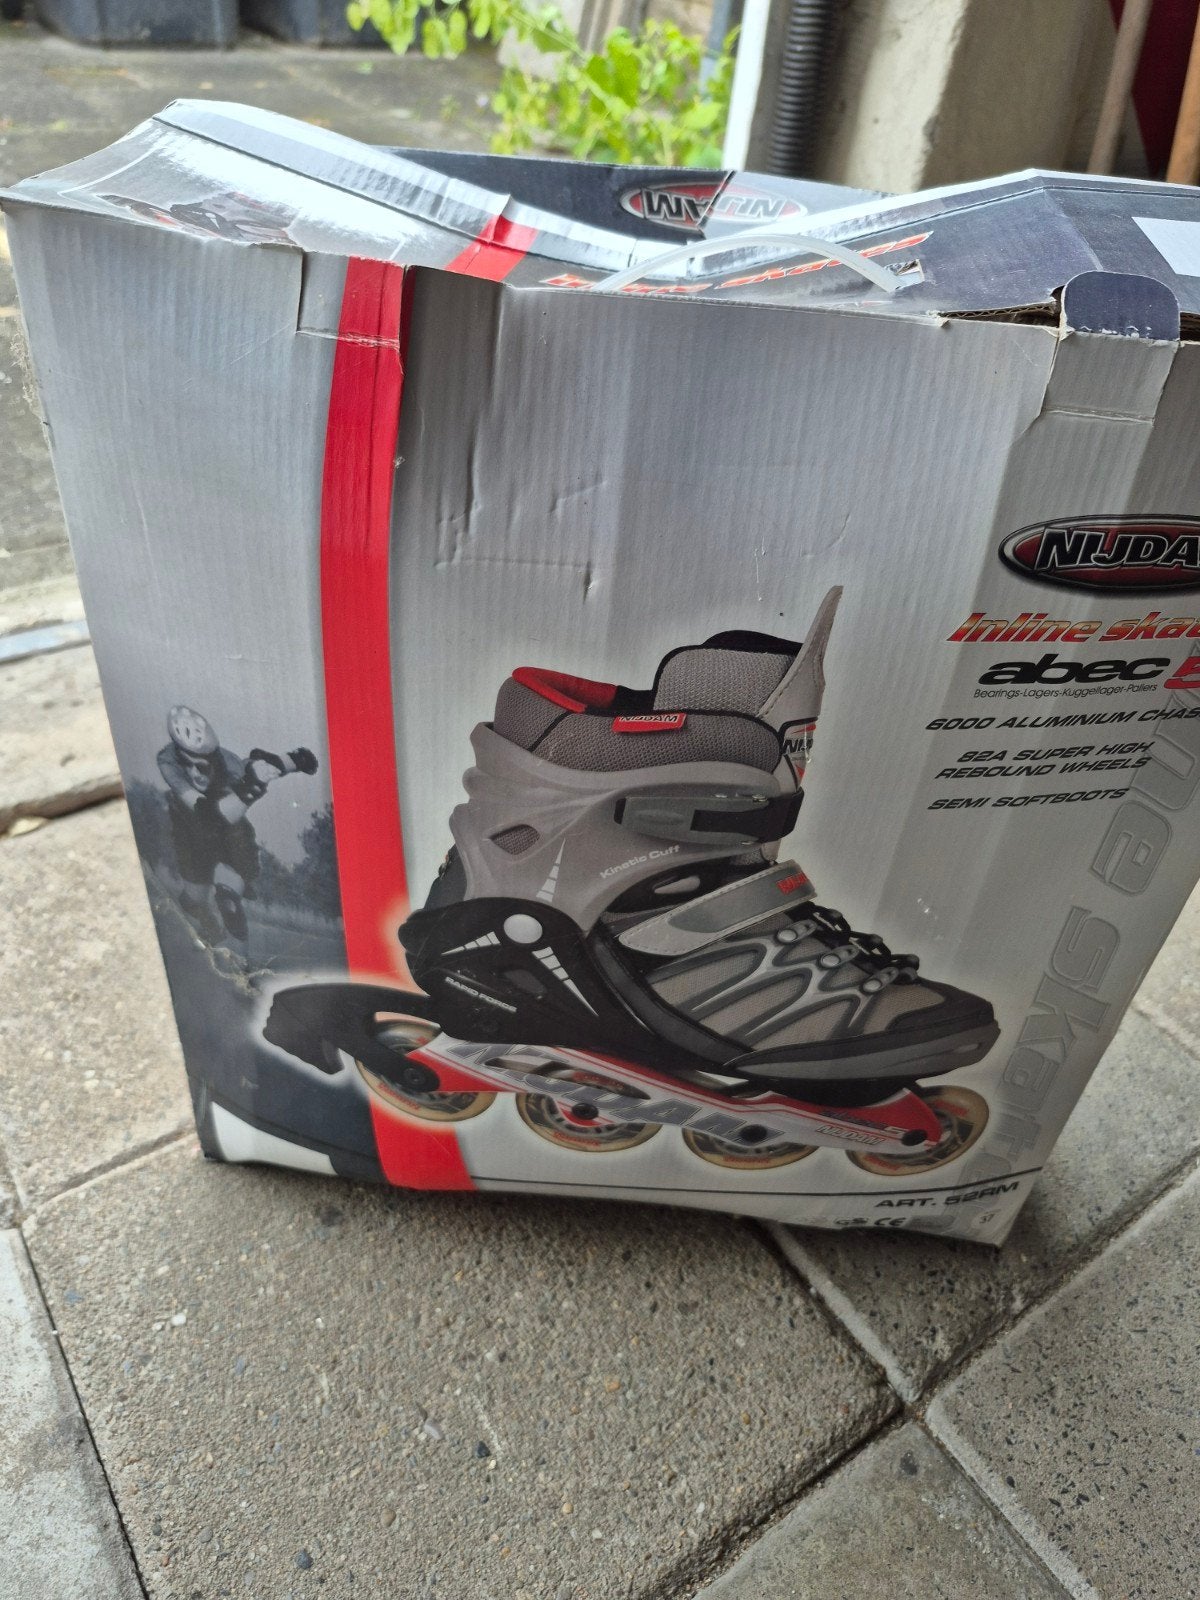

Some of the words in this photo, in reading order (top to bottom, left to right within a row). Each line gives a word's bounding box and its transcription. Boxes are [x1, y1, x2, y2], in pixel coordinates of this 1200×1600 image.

[643, 187, 787, 220] NIJAM
[946, 612, 1103, 643] Inline
[978, 654, 1170, 685] abec
[925, 717, 996, 731] 6000
[996, 710, 1139, 729] ALUMINIUM
[956, 750, 1006, 763] 82A
[1012, 745, 1095, 761] SUPER
[1093, 741, 1155, 755] HIGH
[934, 764, 1056, 779] REBOUND
[1058, 757, 1152, 774] WHEELS
[927, 797, 991, 810] SEMI
[991, 788, 1130, 808] SOFTBOOTS
[599, 855, 648, 879] Kinetic
[648, 844, 680, 860] Cuff
[875, 1197, 937, 1208] ART.
